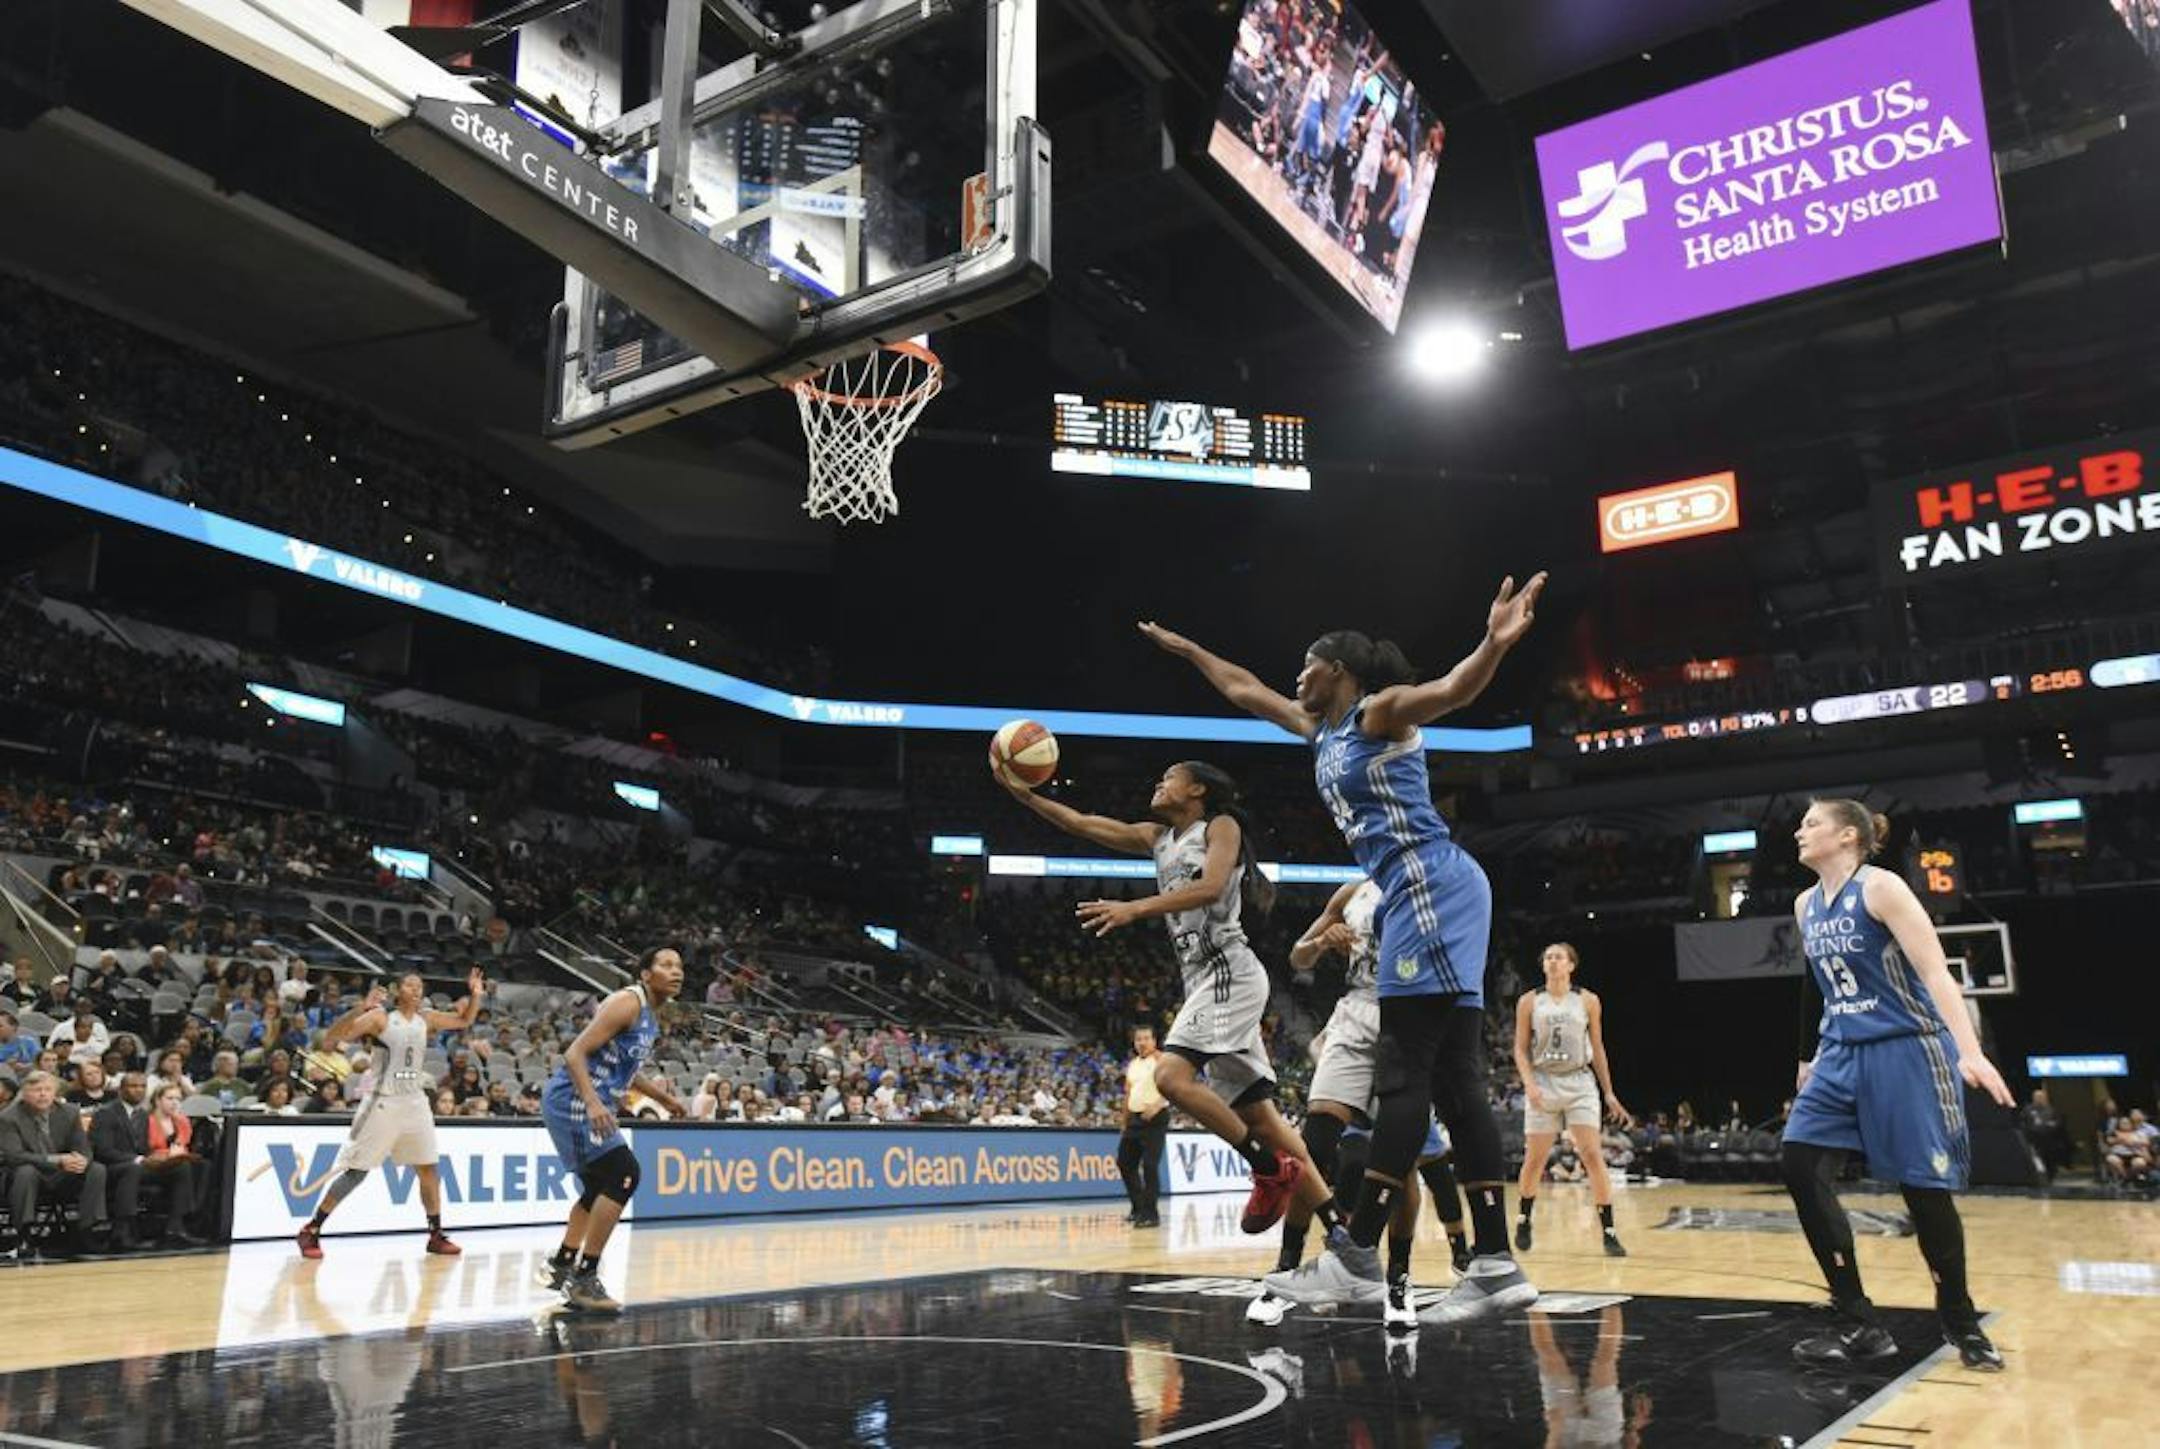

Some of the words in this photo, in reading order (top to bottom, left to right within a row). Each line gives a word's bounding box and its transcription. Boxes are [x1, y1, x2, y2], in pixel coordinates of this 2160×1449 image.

[450, 106, 514, 161] at&t
[521, 153, 639, 242] CENTER
[1674, 159, 1828, 229] SANTA
[1829, 116, 1973, 183] ROSA
[1683, 213, 1797, 269] Health
[1805, 177, 1941, 238] System
[1916, 450, 2143, 528] H-E-B
[1619, 492, 1718, 531] H-E-B
[1900, 521, 2003, 573] FAN
[2017, 491, 2160, 551] ZONE
[334, 558, 423, 600] VALERO
[1878, 693, 1908, 711] SA
[1930, 682, 1968, 707] 22
[2030, 669, 2083, 692] 2:56
[827, 704, 904, 722] VALERO
[1741, 711, 1776, 729] 37%
[1819, 955, 1859, 998] 13
[656, 1147, 758, 1196] Drive
[769, 1146, 875, 1192] Clean.
[883, 1146, 967, 1188] Clean
[973, 1146, 1060, 1186] Across
[1210, 1149, 1249, 1177] VAL
